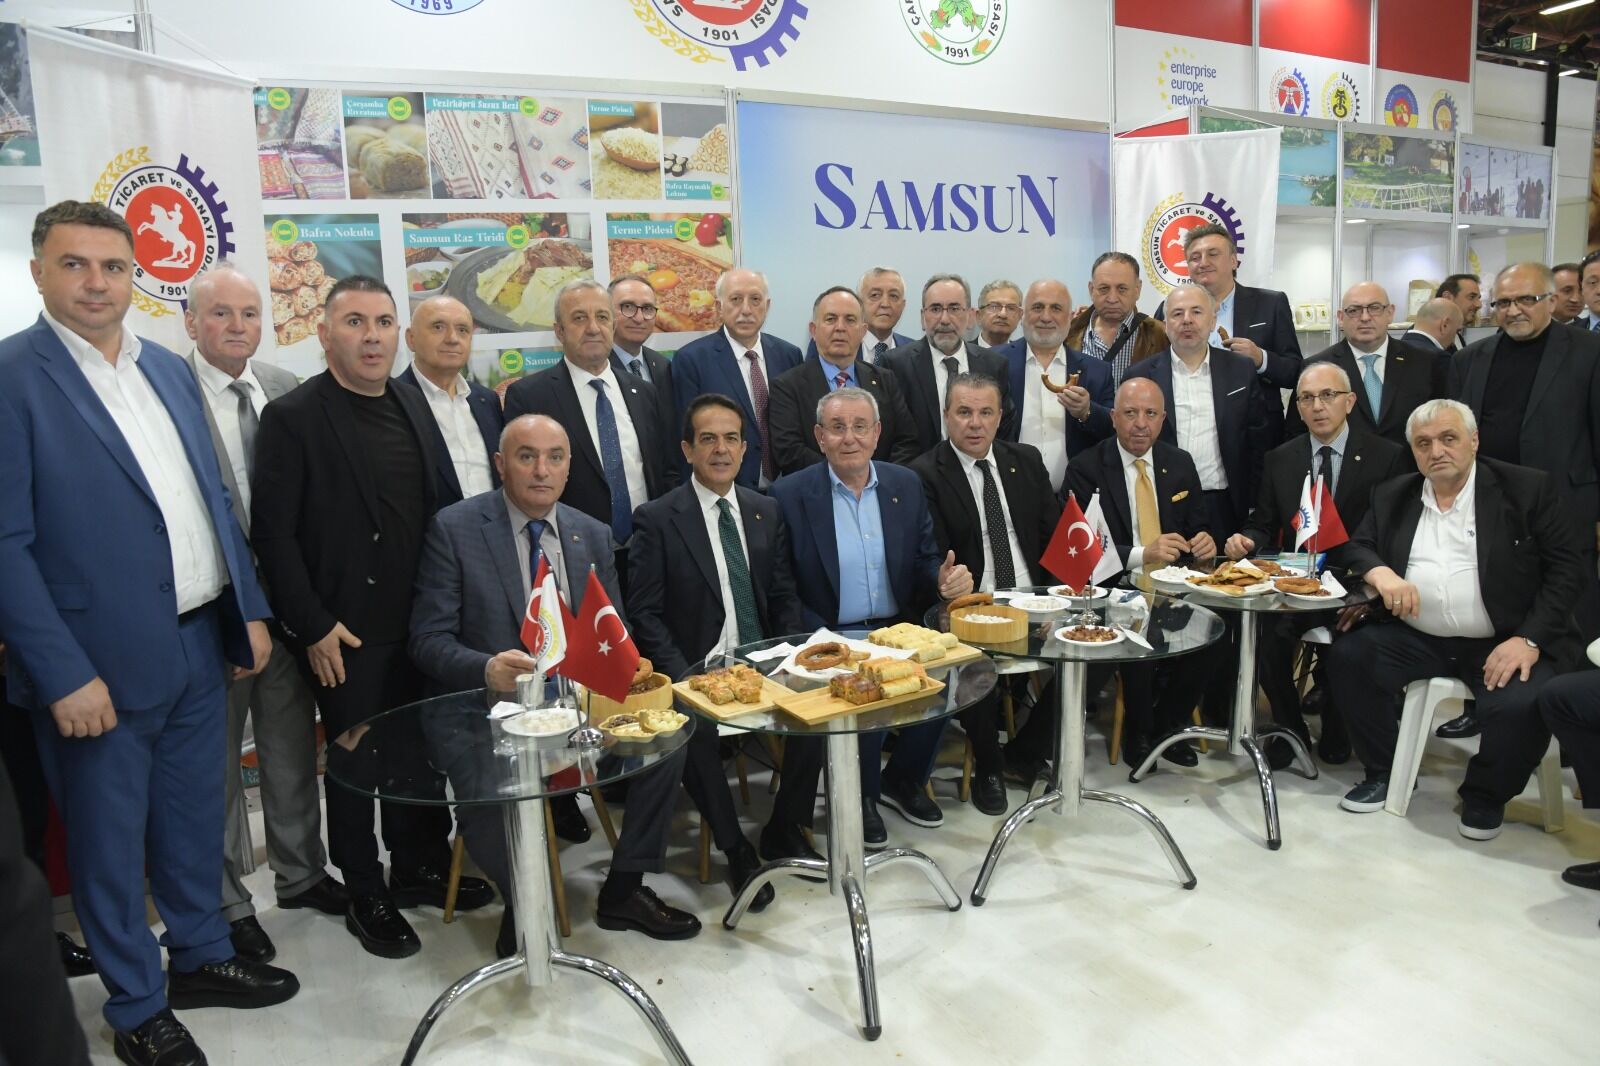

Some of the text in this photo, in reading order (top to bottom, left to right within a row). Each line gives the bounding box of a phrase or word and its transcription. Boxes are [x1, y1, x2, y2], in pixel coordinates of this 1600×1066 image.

[702, 27, 740, 41] 1901
[945, 46, 970, 57] 1991
[1171, 62, 1217, 80] enterprise
[1171, 79, 1204, 95] europe
[1172, 94, 1209, 106] network
[115, 173, 165, 208] TİCARET
[170, 178, 182, 189] ve
[185, 188, 216, 239] SANAYİ
[814, 163, 1058, 237] SAMSUN
[1157, 207, 1191, 232] TİCARET
[301, 227, 375, 238] Bafra Nokulu
[612, 225, 673, 235] Terme Pidesi
[409, 232, 505, 244] Samsun Kaz Tiridi
[1153, 236, 1169, 275] SAMSUN
[160, 285, 188, 296] 1901
